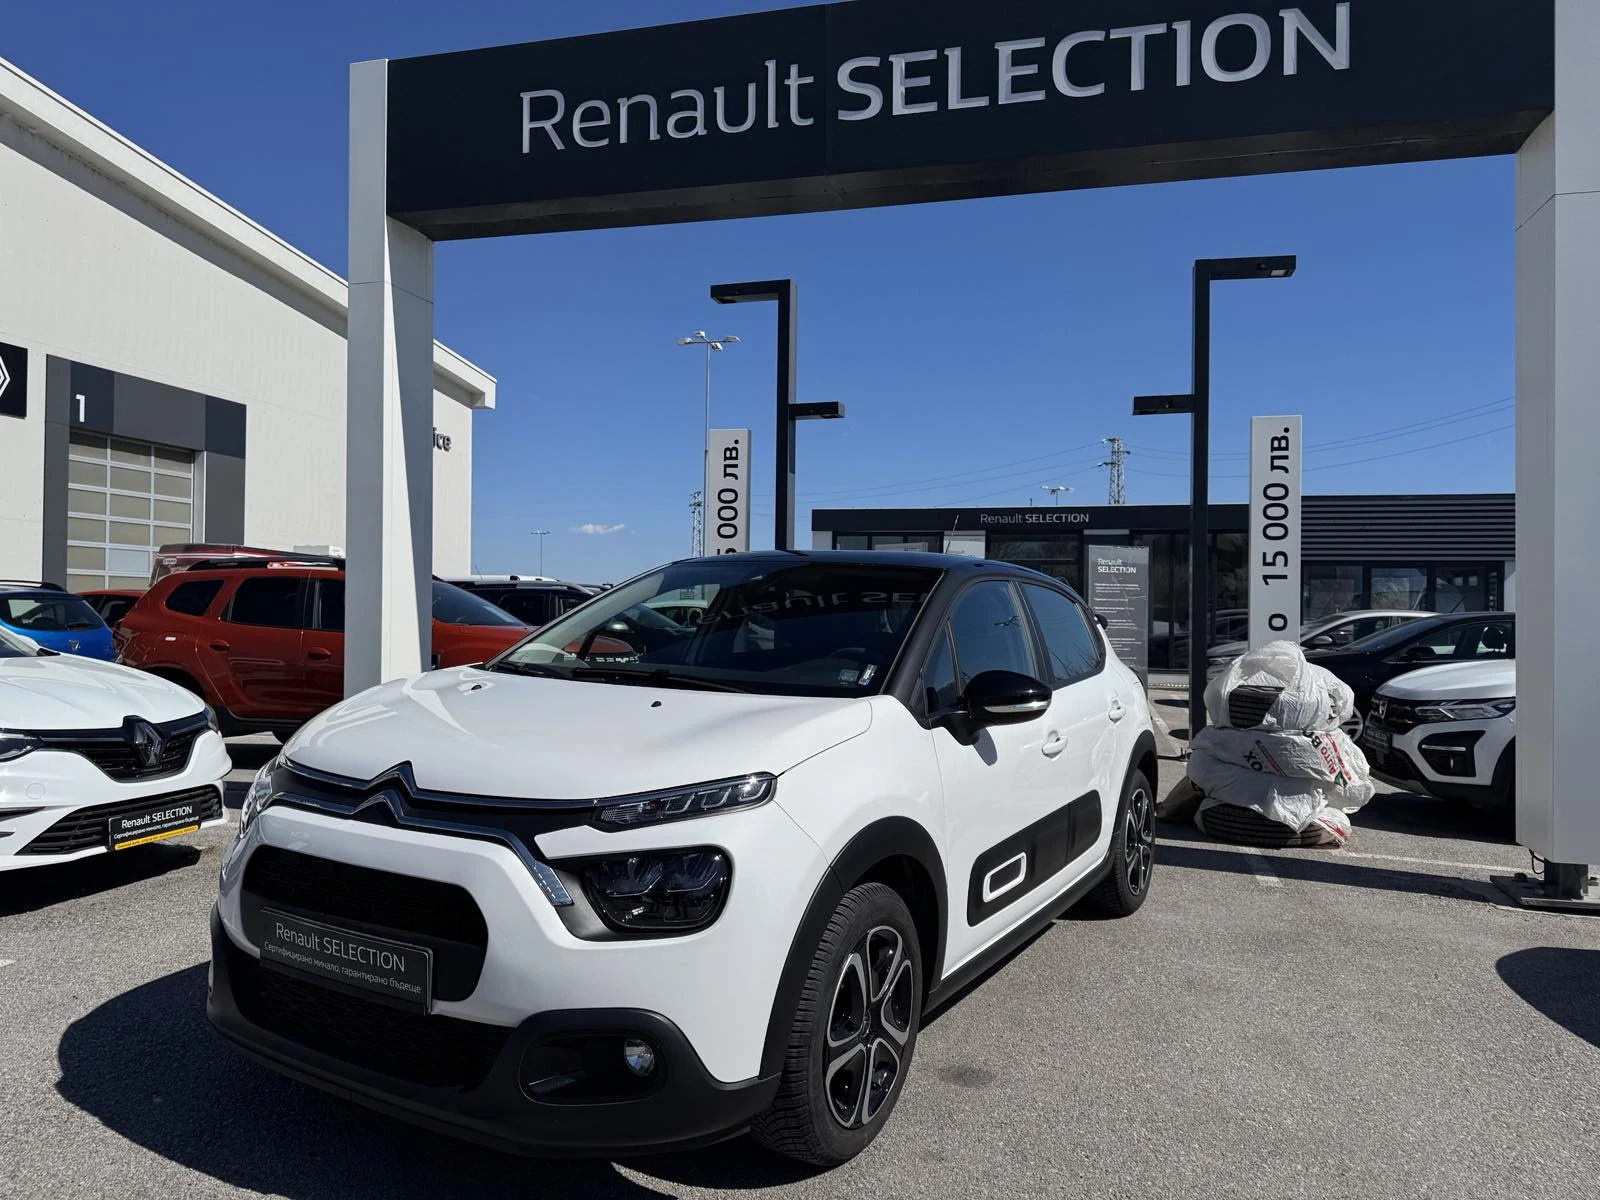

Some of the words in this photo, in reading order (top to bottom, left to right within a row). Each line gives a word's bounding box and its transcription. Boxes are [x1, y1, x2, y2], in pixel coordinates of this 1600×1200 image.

[519, 59, 814, 154] Renault
[836, 1, 1350, 121] SELECTION
[75, 393, 86, 423] 1
[723, 439, 740, 481] лв.
[1270, 426, 1290, 474] лв.
[717, 488, 739, 540] 000
[980, 513, 1024, 524] Renault
[1025, 513, 1089, 523] SELECTION
[1262, 482, 1290, 541] 000
[1097, 566, 1137, 574] SELECTION
[1262, 550, 1289, 586] 15
[1321, 746, 1337, 775] AUTO
[121, 814, 151, 829] Renault
[152, 805, 193, 823] SELECTION
[264, 941, 313, 966] Сертифицирано
[313, 958, 341, 975] минало,
[341, 966, 389, 986] гарантирано
[389, 977, 422, 994] бъдеще
[276, 922, 320, 951] Renault
[323, 937, 405, 973] SELECTION
